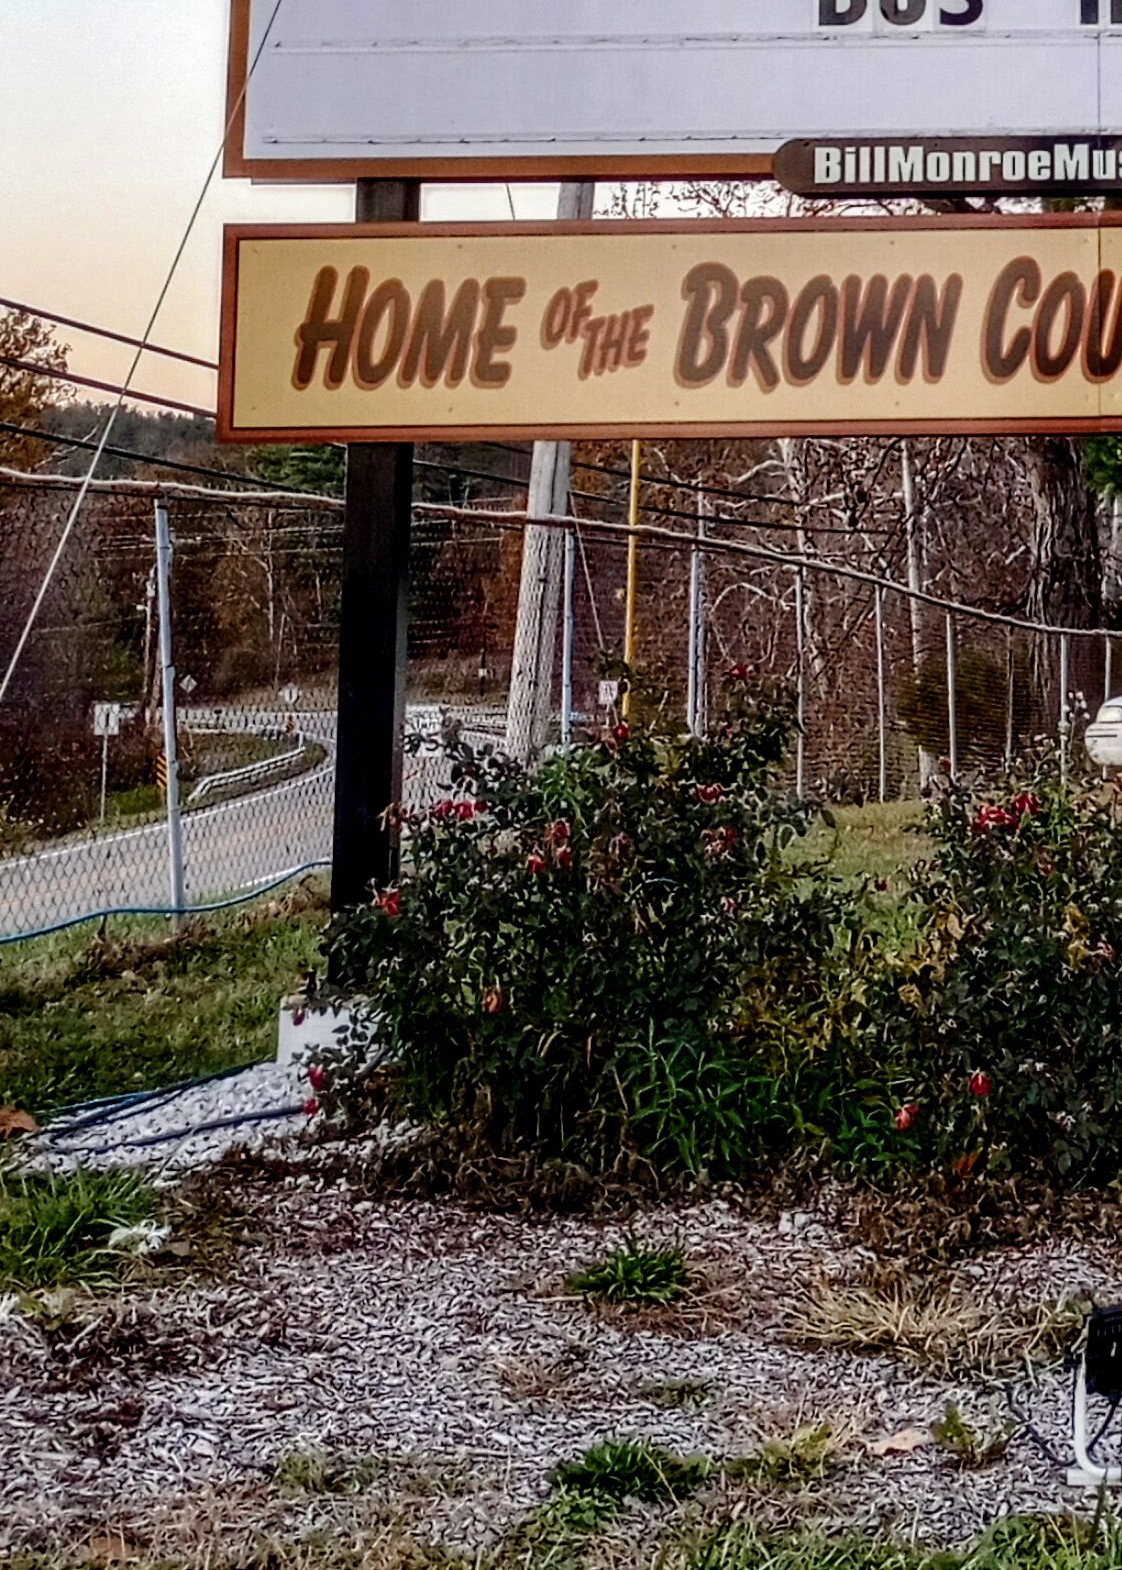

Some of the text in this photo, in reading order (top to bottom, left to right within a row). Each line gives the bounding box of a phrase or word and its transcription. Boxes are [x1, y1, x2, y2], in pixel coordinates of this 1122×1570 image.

[291, 264, 526, 392] HOME
[540, 279, 599, 350] OF
[577, 303, 655, 381] THE
[672, 260, 964, 394] BROWN
